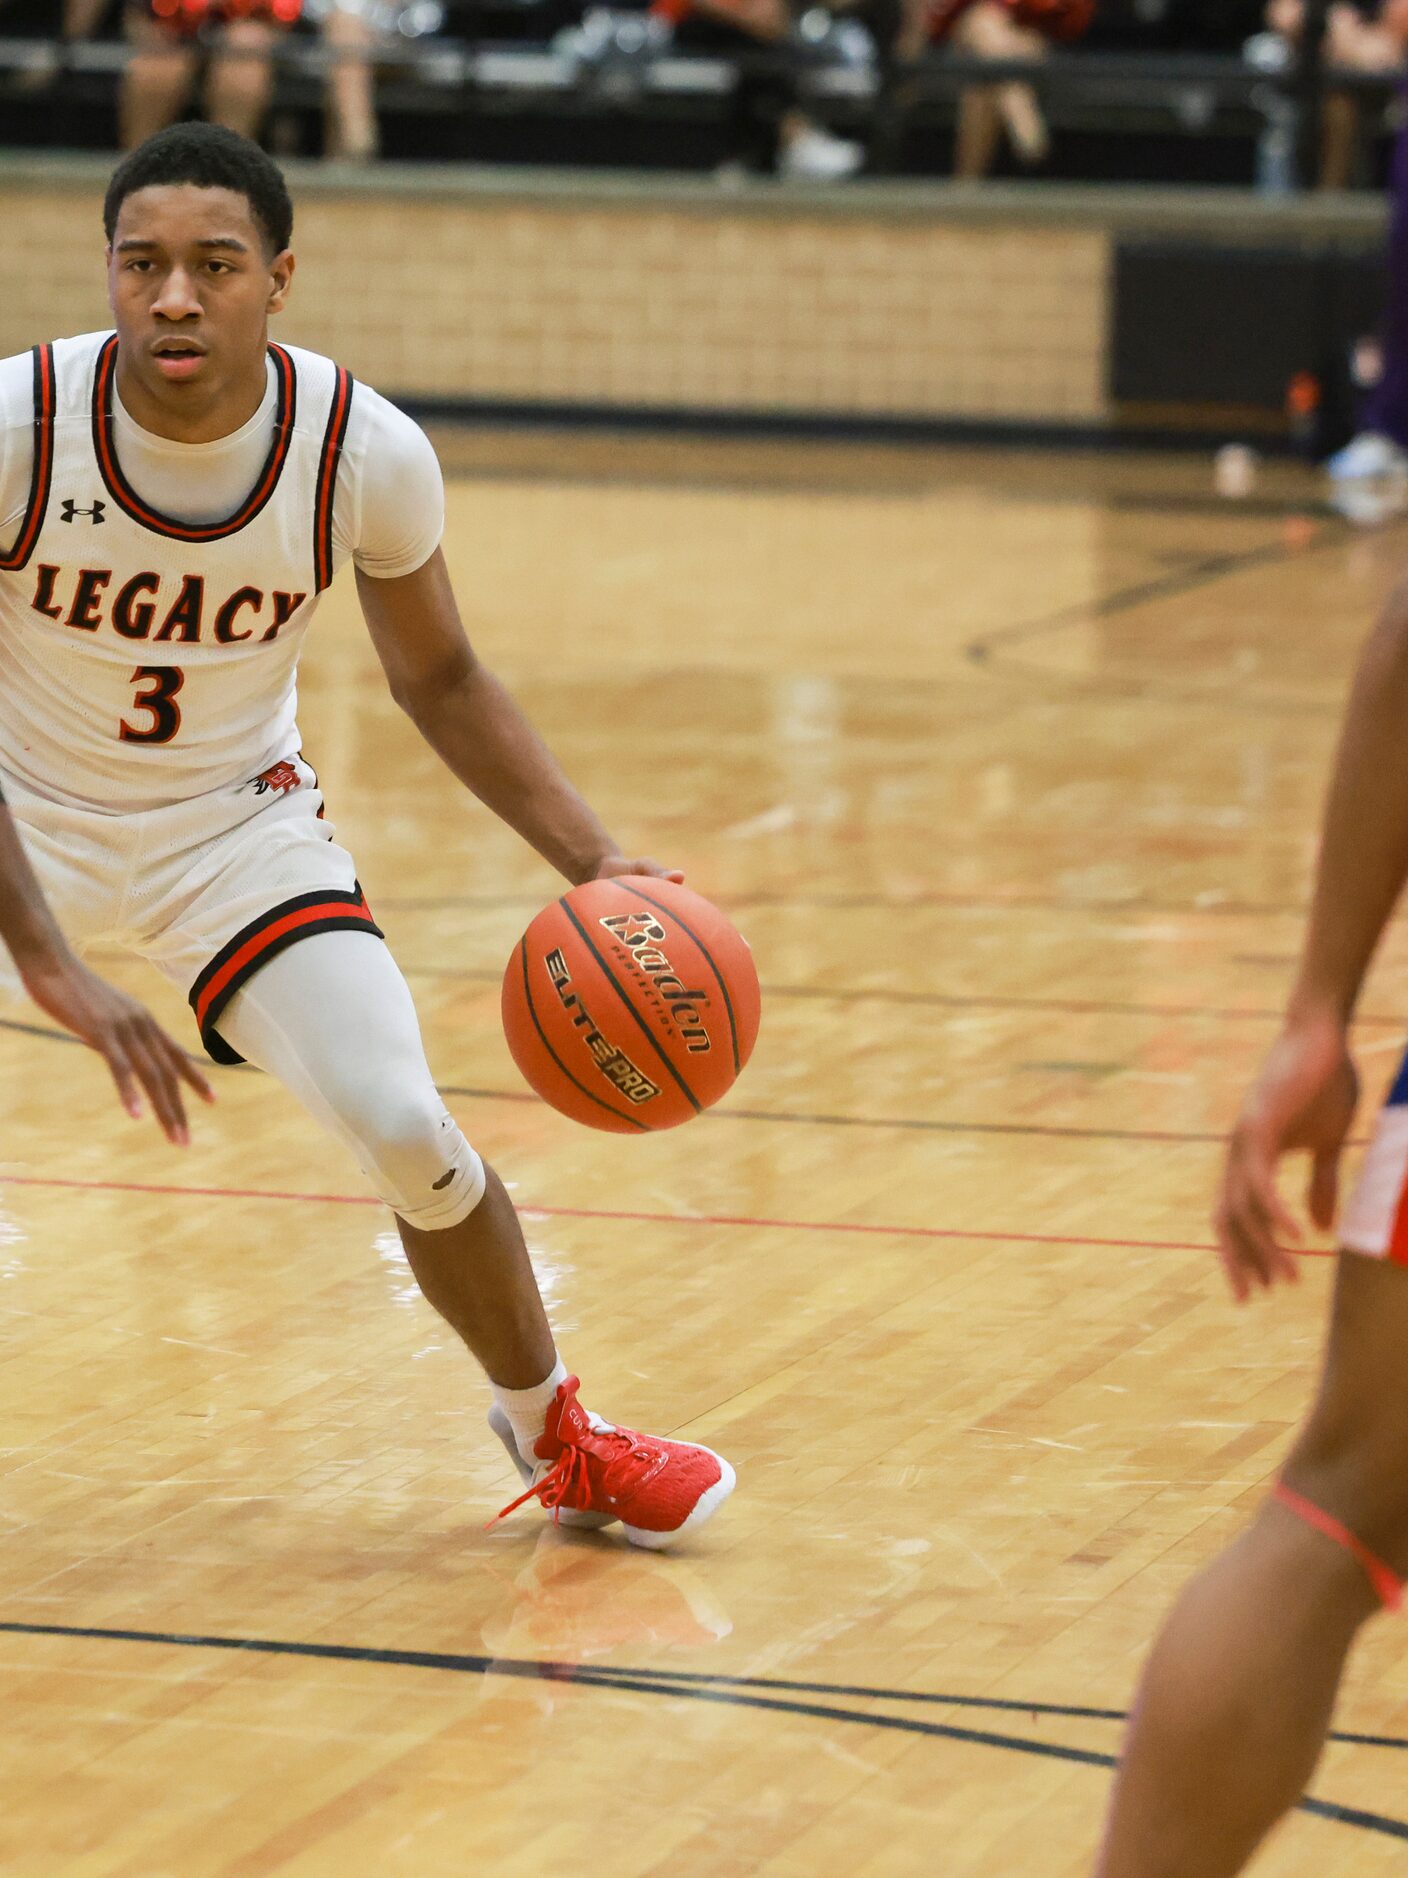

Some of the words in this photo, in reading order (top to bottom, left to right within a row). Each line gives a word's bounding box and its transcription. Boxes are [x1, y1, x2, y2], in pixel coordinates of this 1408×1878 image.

[31, 563, 307, 644] LEGACY
[118, 665, 185, 744] 3
[598, 911, 711, 1054] Baden
